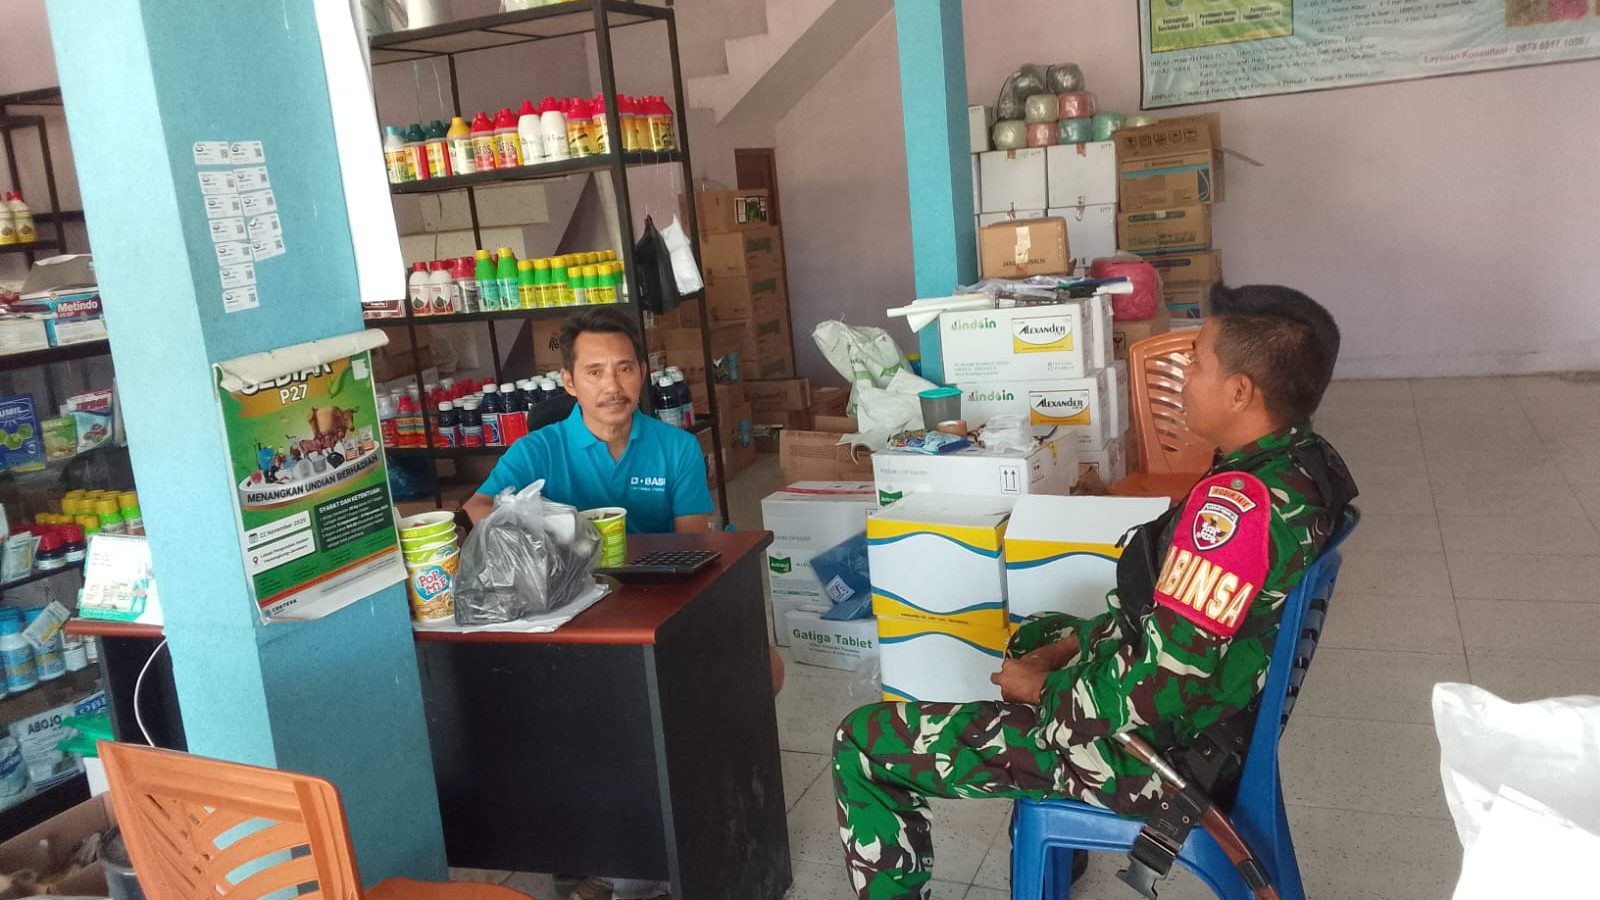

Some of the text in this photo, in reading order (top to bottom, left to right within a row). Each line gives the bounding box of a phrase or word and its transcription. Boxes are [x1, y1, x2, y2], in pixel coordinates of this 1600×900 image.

[57, 300, 97, 313] Metindo
[280, 384, 307, 404] P27
[247, 453, 378, 503] MENANGKAN UNDIAN BERHADIAH
[644, 477, 665, 486] BAS
[419, 570, 438, 586] POP
[834, 633, 872, 648] Tablet
